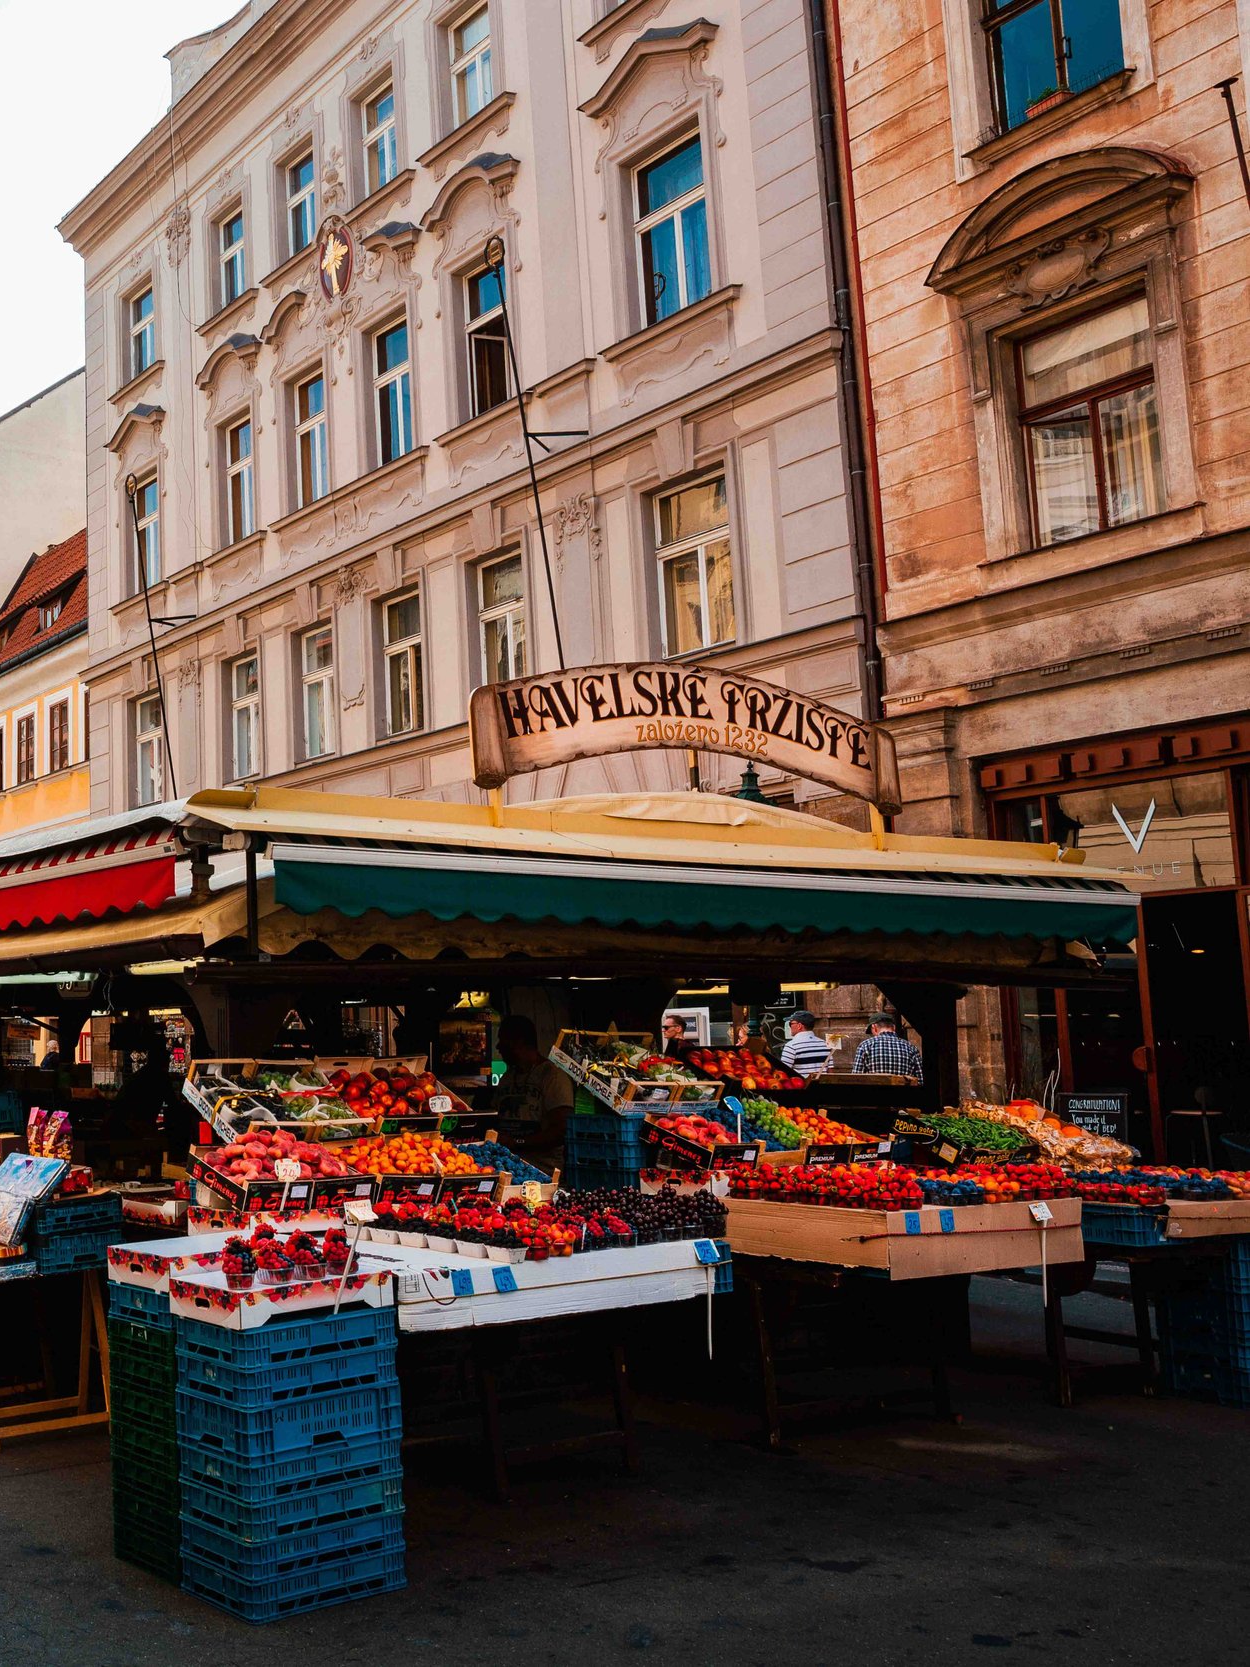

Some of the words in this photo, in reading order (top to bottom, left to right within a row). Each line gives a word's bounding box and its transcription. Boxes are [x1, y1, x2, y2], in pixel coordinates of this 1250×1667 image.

[497, 668, 714, 740] HAVELSKÉ
[634, 722, 719, 746] založeno
[724, 725, 769, 757] 1232
[1084, 1114, 1100, 1124] made
[1102, 1124, 1117, 1133] BED!
